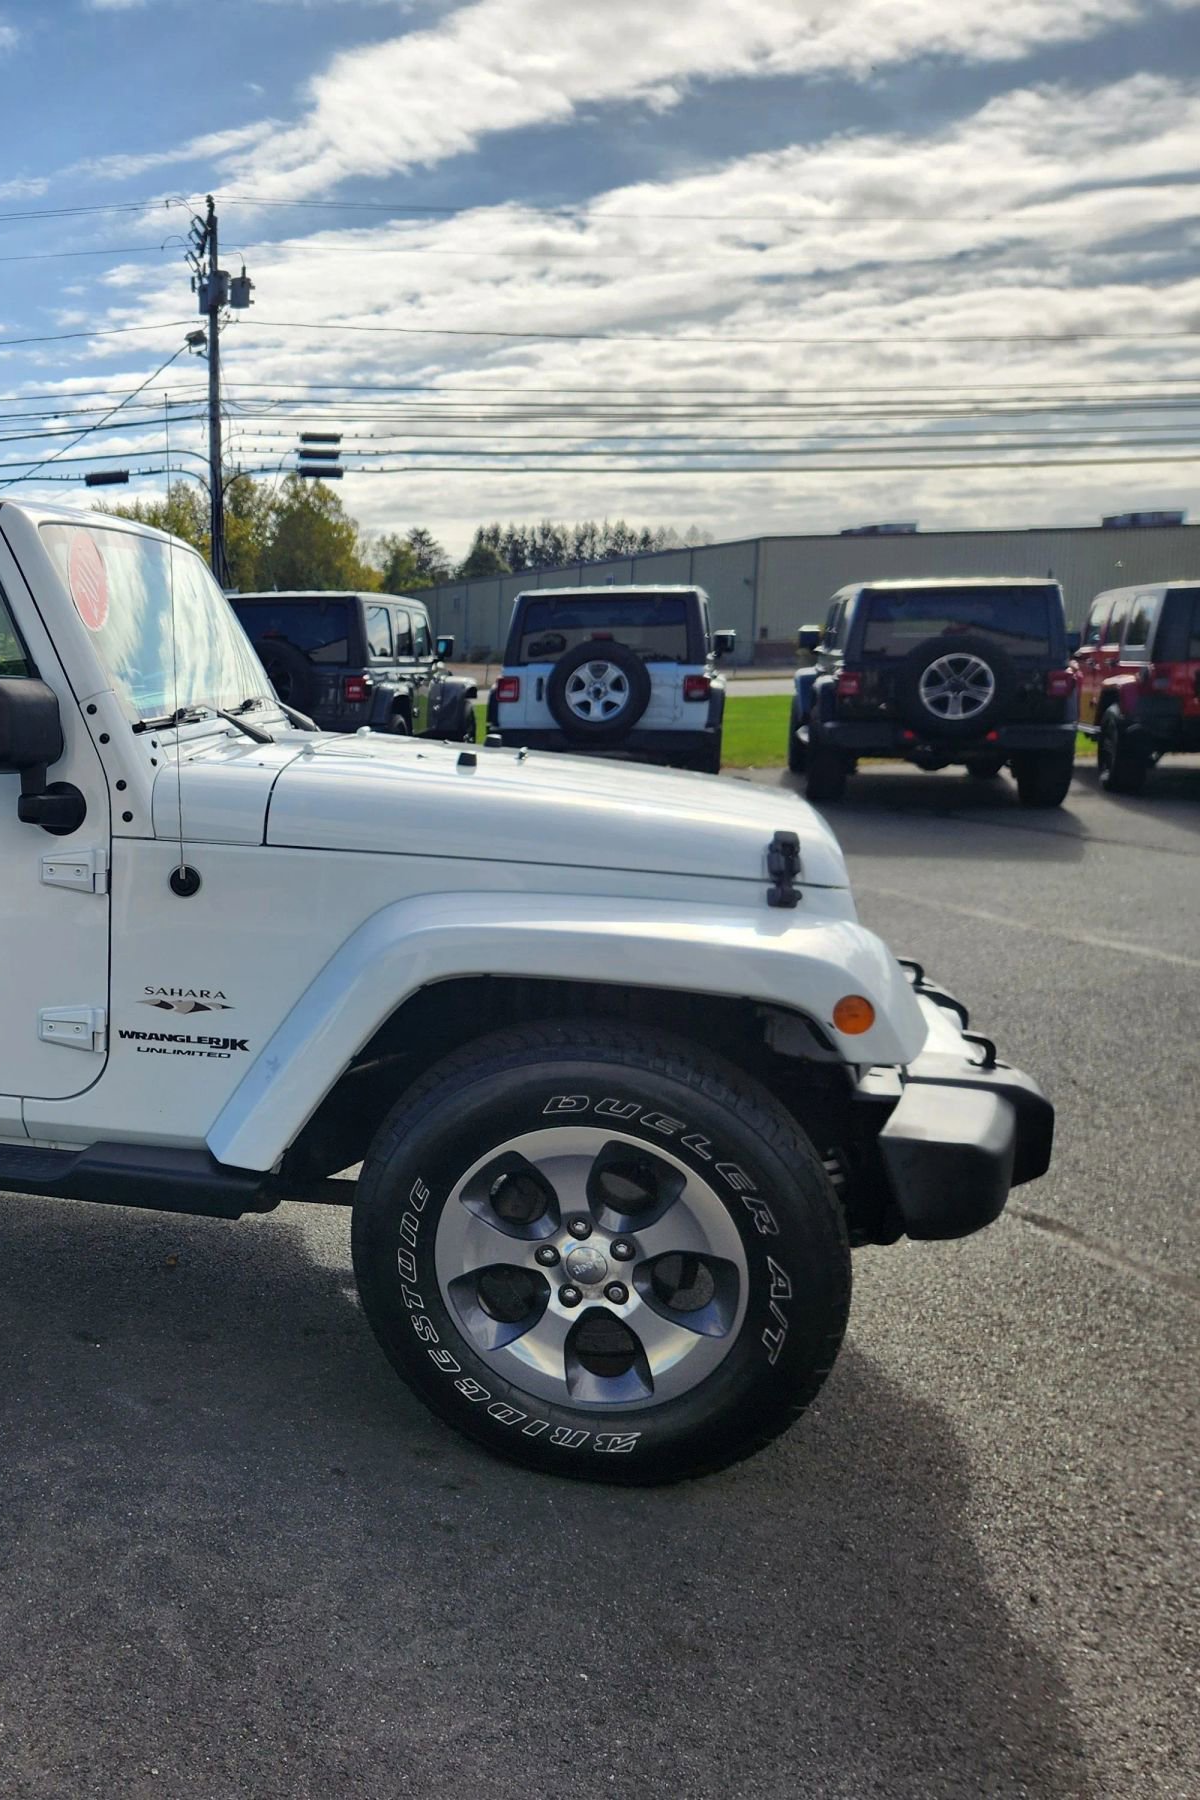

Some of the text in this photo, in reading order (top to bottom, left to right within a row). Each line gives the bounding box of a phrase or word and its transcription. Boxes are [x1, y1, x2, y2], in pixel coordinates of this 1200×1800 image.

[137, 1047, 231, 1059] UNLIMITED
[144, 986, 227, 999] SAHARA
[543, 1094, 792, 1366] DUELER A/T
[398, 1177, 642, 1453] BRIDGESTONE
